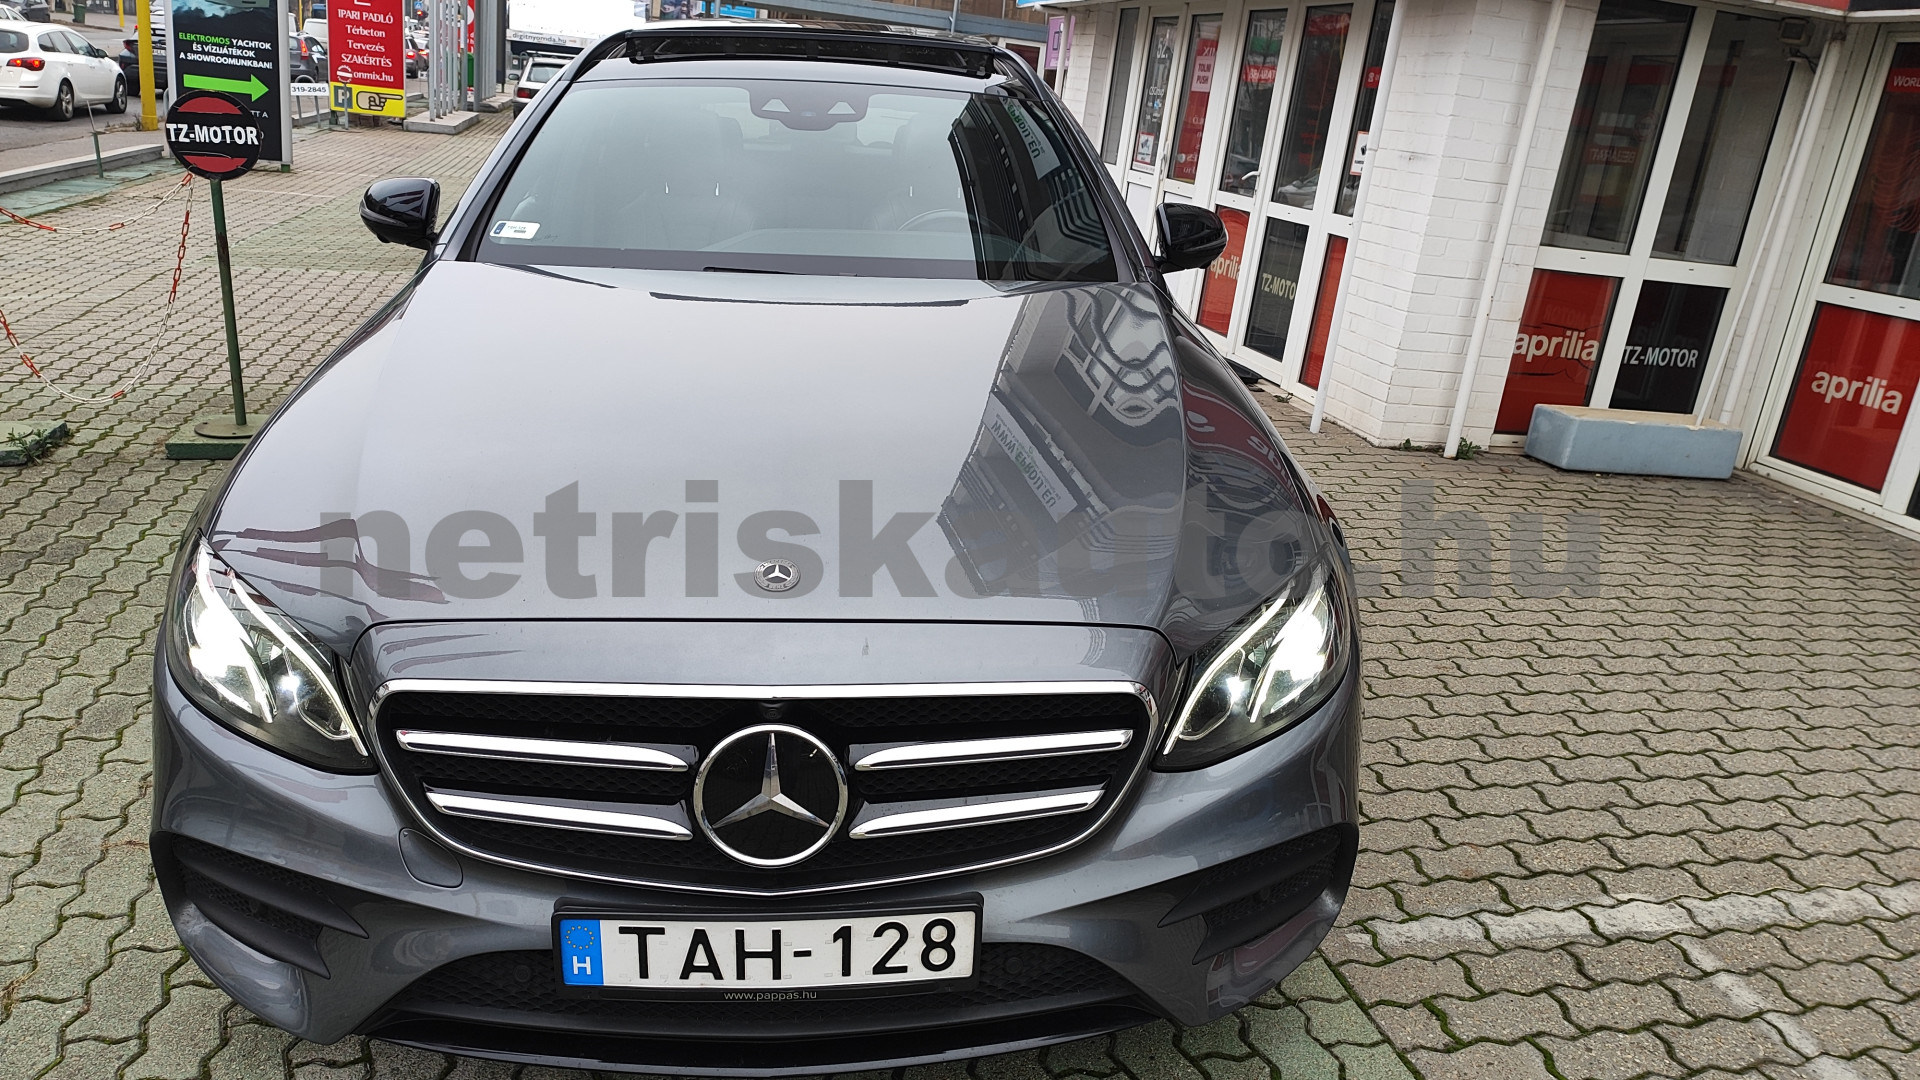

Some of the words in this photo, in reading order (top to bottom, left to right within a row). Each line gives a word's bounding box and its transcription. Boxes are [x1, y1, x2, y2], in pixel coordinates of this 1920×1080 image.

[338, 9, 360, 20] IPARI
[362, 12, 394, 24] PADLÓ
[345, 25, 386, 38] Térbeton
[179, 32, 230, 45] ELEKTROMOS
[231, 39, 272, 50] YACHTOK
[347, 39, 385, 52] Tervezés
[193, 42, 202, 52] ÉS
[202, 44, 256, 58] VÍZIJÁTÉKOK
[187, 53, 273, 69] SHOWROOMUNKBAN!
[341, 53, 393, 68] SZAKÉRTÉS
[353, 71, 394, 82] onmix.hu
[1196, 75, 1209, 85] PUSH
[291, 86, 327, 94] 319-2845
[262, 110, 269, 119] A
[165, 123, 259, 145] TZ-MOTOR
[1513, 330, 1600, 362] aprilia
[1623, 345, 1699, 368] TZ-MOTOR
[1811, 371, 1903, 415] aprilia
[617, 916, 957, 981] TAH-128
[571, 955, 592, 976] H
[723, 988, 818, 1002] www.pappas.hu
